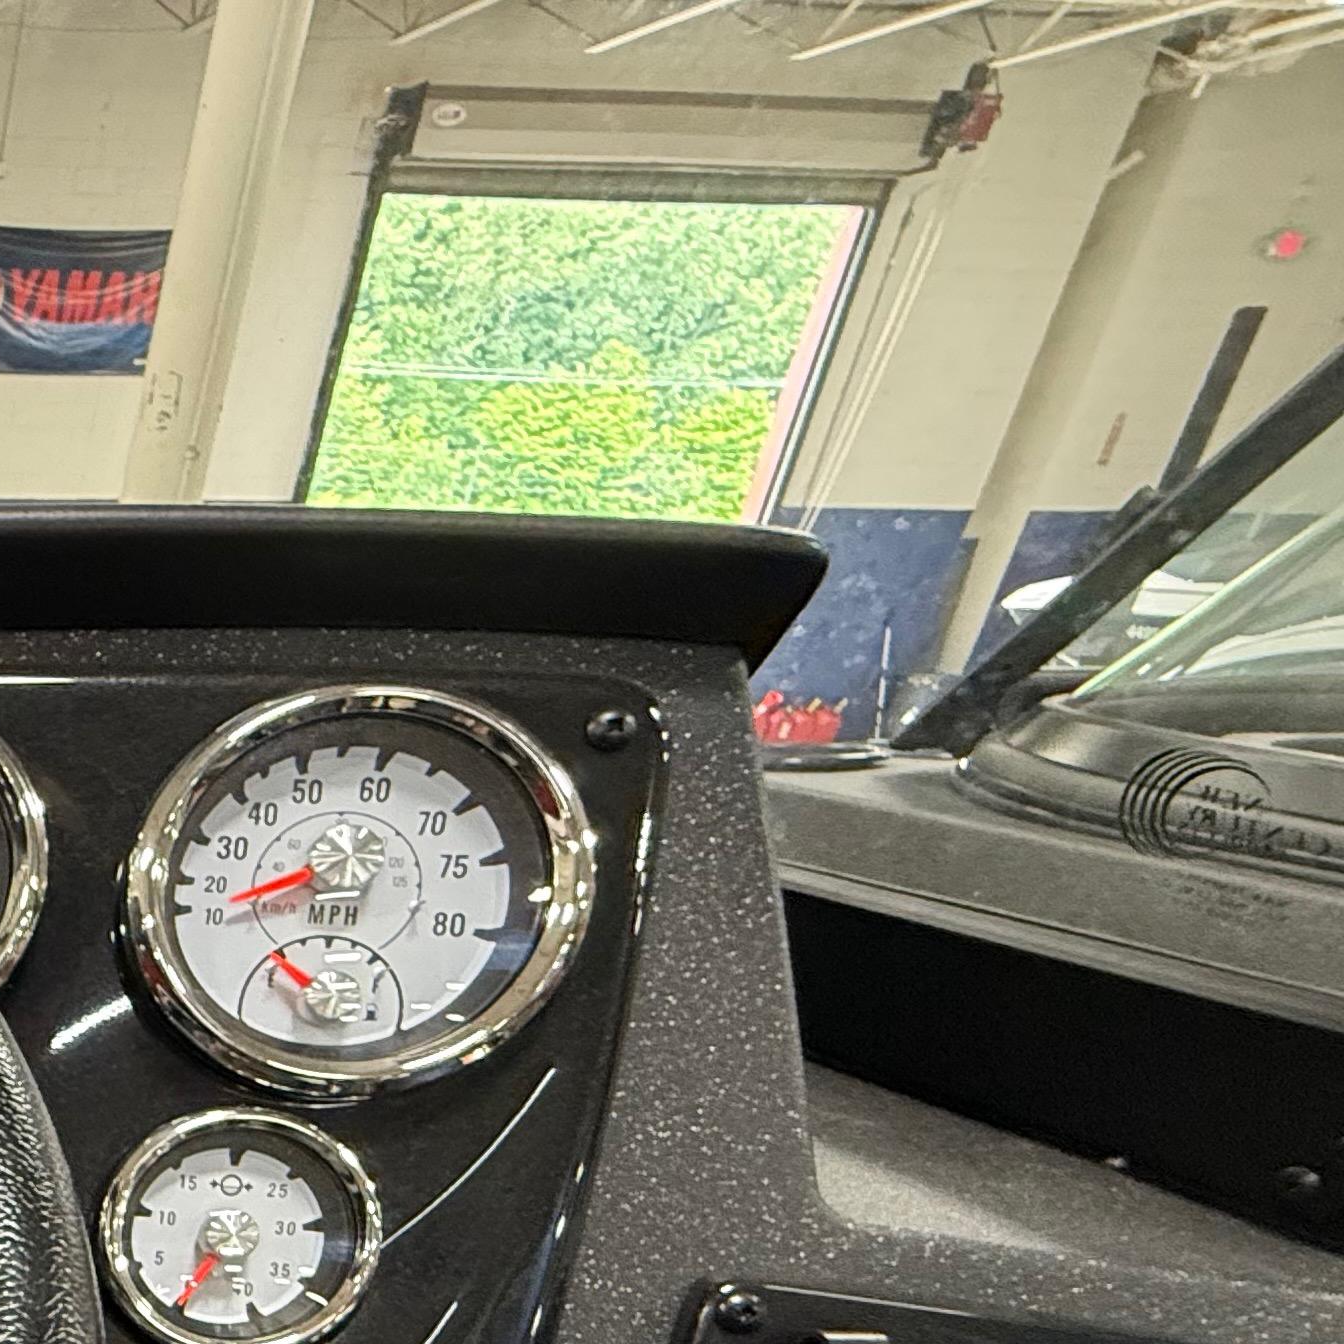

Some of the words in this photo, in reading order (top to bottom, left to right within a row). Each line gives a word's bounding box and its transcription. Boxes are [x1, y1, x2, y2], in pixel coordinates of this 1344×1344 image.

[292, 779, 323, 804] 50
[359, 777, 391, 802] 60
[248, 802, 278, 826] 40
[418, 811, 448, 836] 70
[217, 836, 248, 860] 30
[441, 854, 469, 879] 75
[204, 876, 227, 894] 20
[261, 901, 297, 914] km/h
[308, 904, 360, 926] MPH
[205, 908, 224, 926] 10
[433, 912, 466, 937] 80
[180, 1174, 197, 1191] 15
[267, 1183, 289, 1199] 25
[159, 1210, 177, 1226] 10
[274, 1221, 296, 1236] 30
[154, 1250, 165, 1266] 5
[270, 1262, 291, 1277] 35
